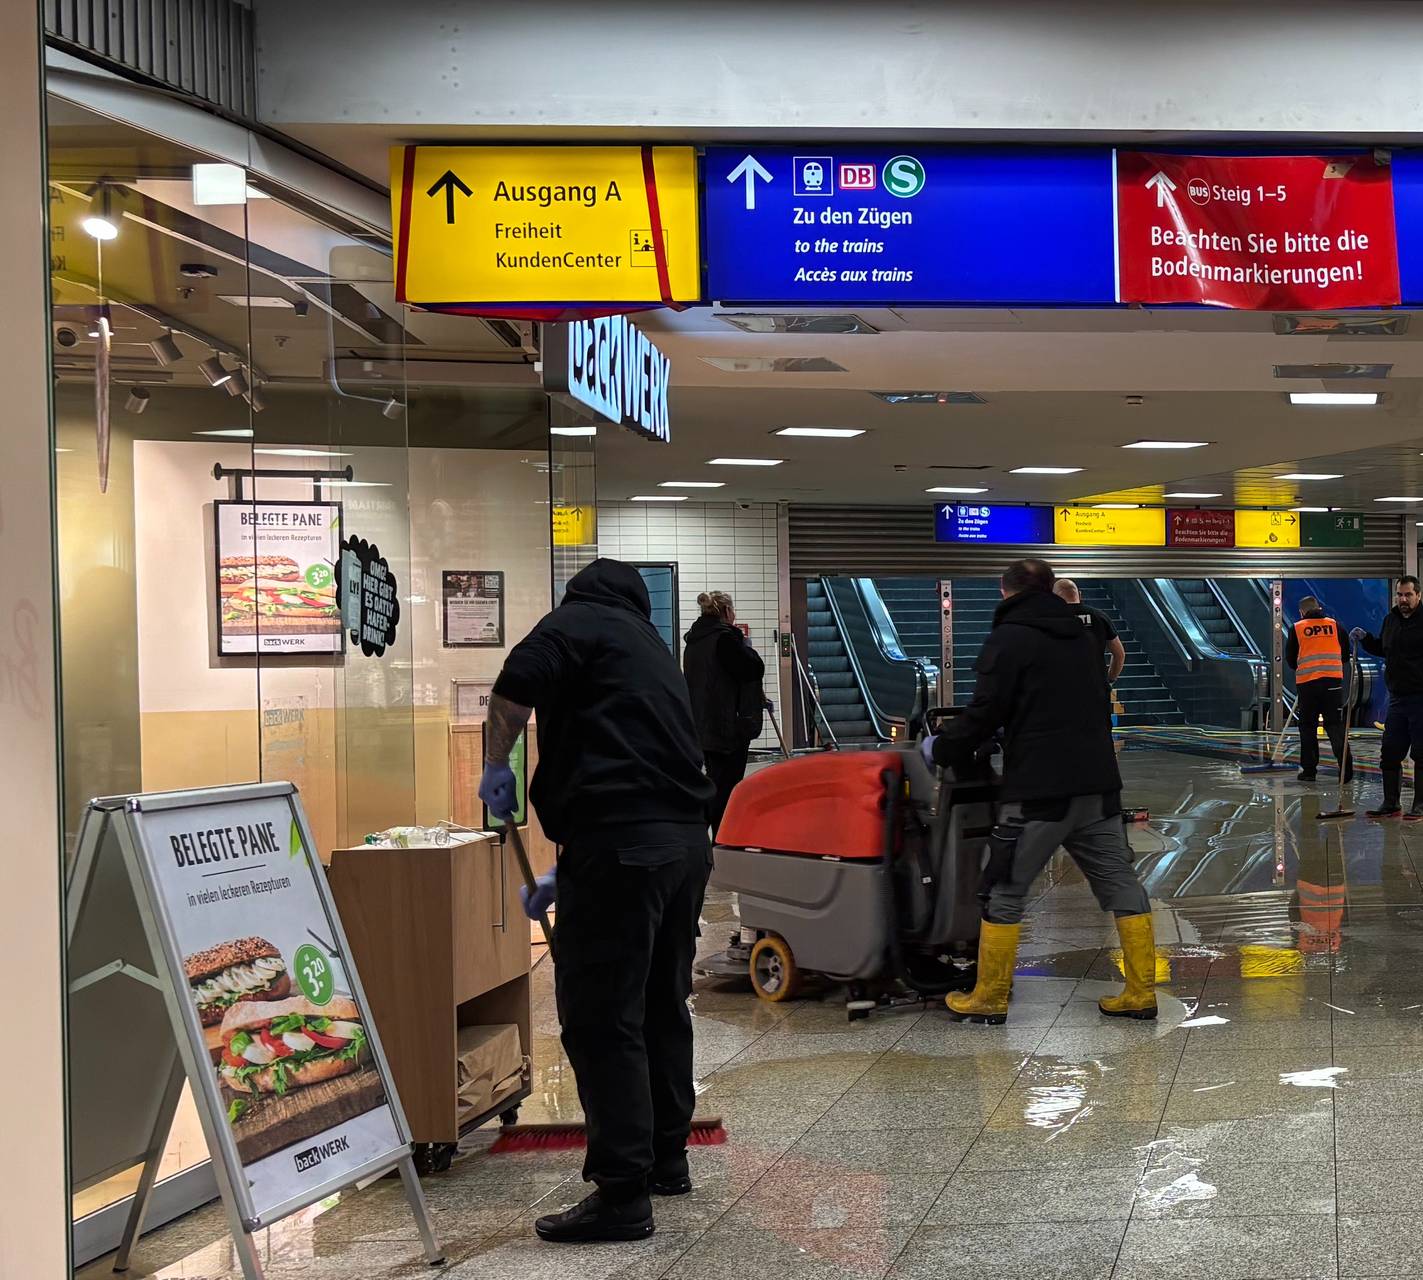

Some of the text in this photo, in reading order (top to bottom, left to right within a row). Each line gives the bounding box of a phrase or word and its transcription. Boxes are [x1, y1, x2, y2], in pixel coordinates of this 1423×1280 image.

[843, 167, 873, 187] DB
[890, 159, 919, 193] S
[494, 180, 622, 207] Ausgang A
[1189, 186, 1208, 198] BUS
[1212, 185, 1251, 206] Steig
[793, 205, 912, 231] Zu den Zügen
[494, 221, 562, 241] Freiheit
[1151, 226, 1369, 253] Beachten Sie bitte die
[794, 237, 884, 254] to the trains
[495, 251, 622, 270] KundenCenter
[794, 265, 913, 282] Accès aux trains
[1151, 256, 1363, 288] Bodenmarkierungen!
[241, 512, 322, 526] BELEGTE PANE
[370, 561, 387, 580] OMG!
[363, 573, 379, 593] HIER
[365, 591, 394, 618] ES OATLY
[1304, 625, 1333, 636] OPTI
[169, 821, 280, 868] BELEGTE PANE
[186, 876, 291, 907] in vielen leckeren Rezepturen
